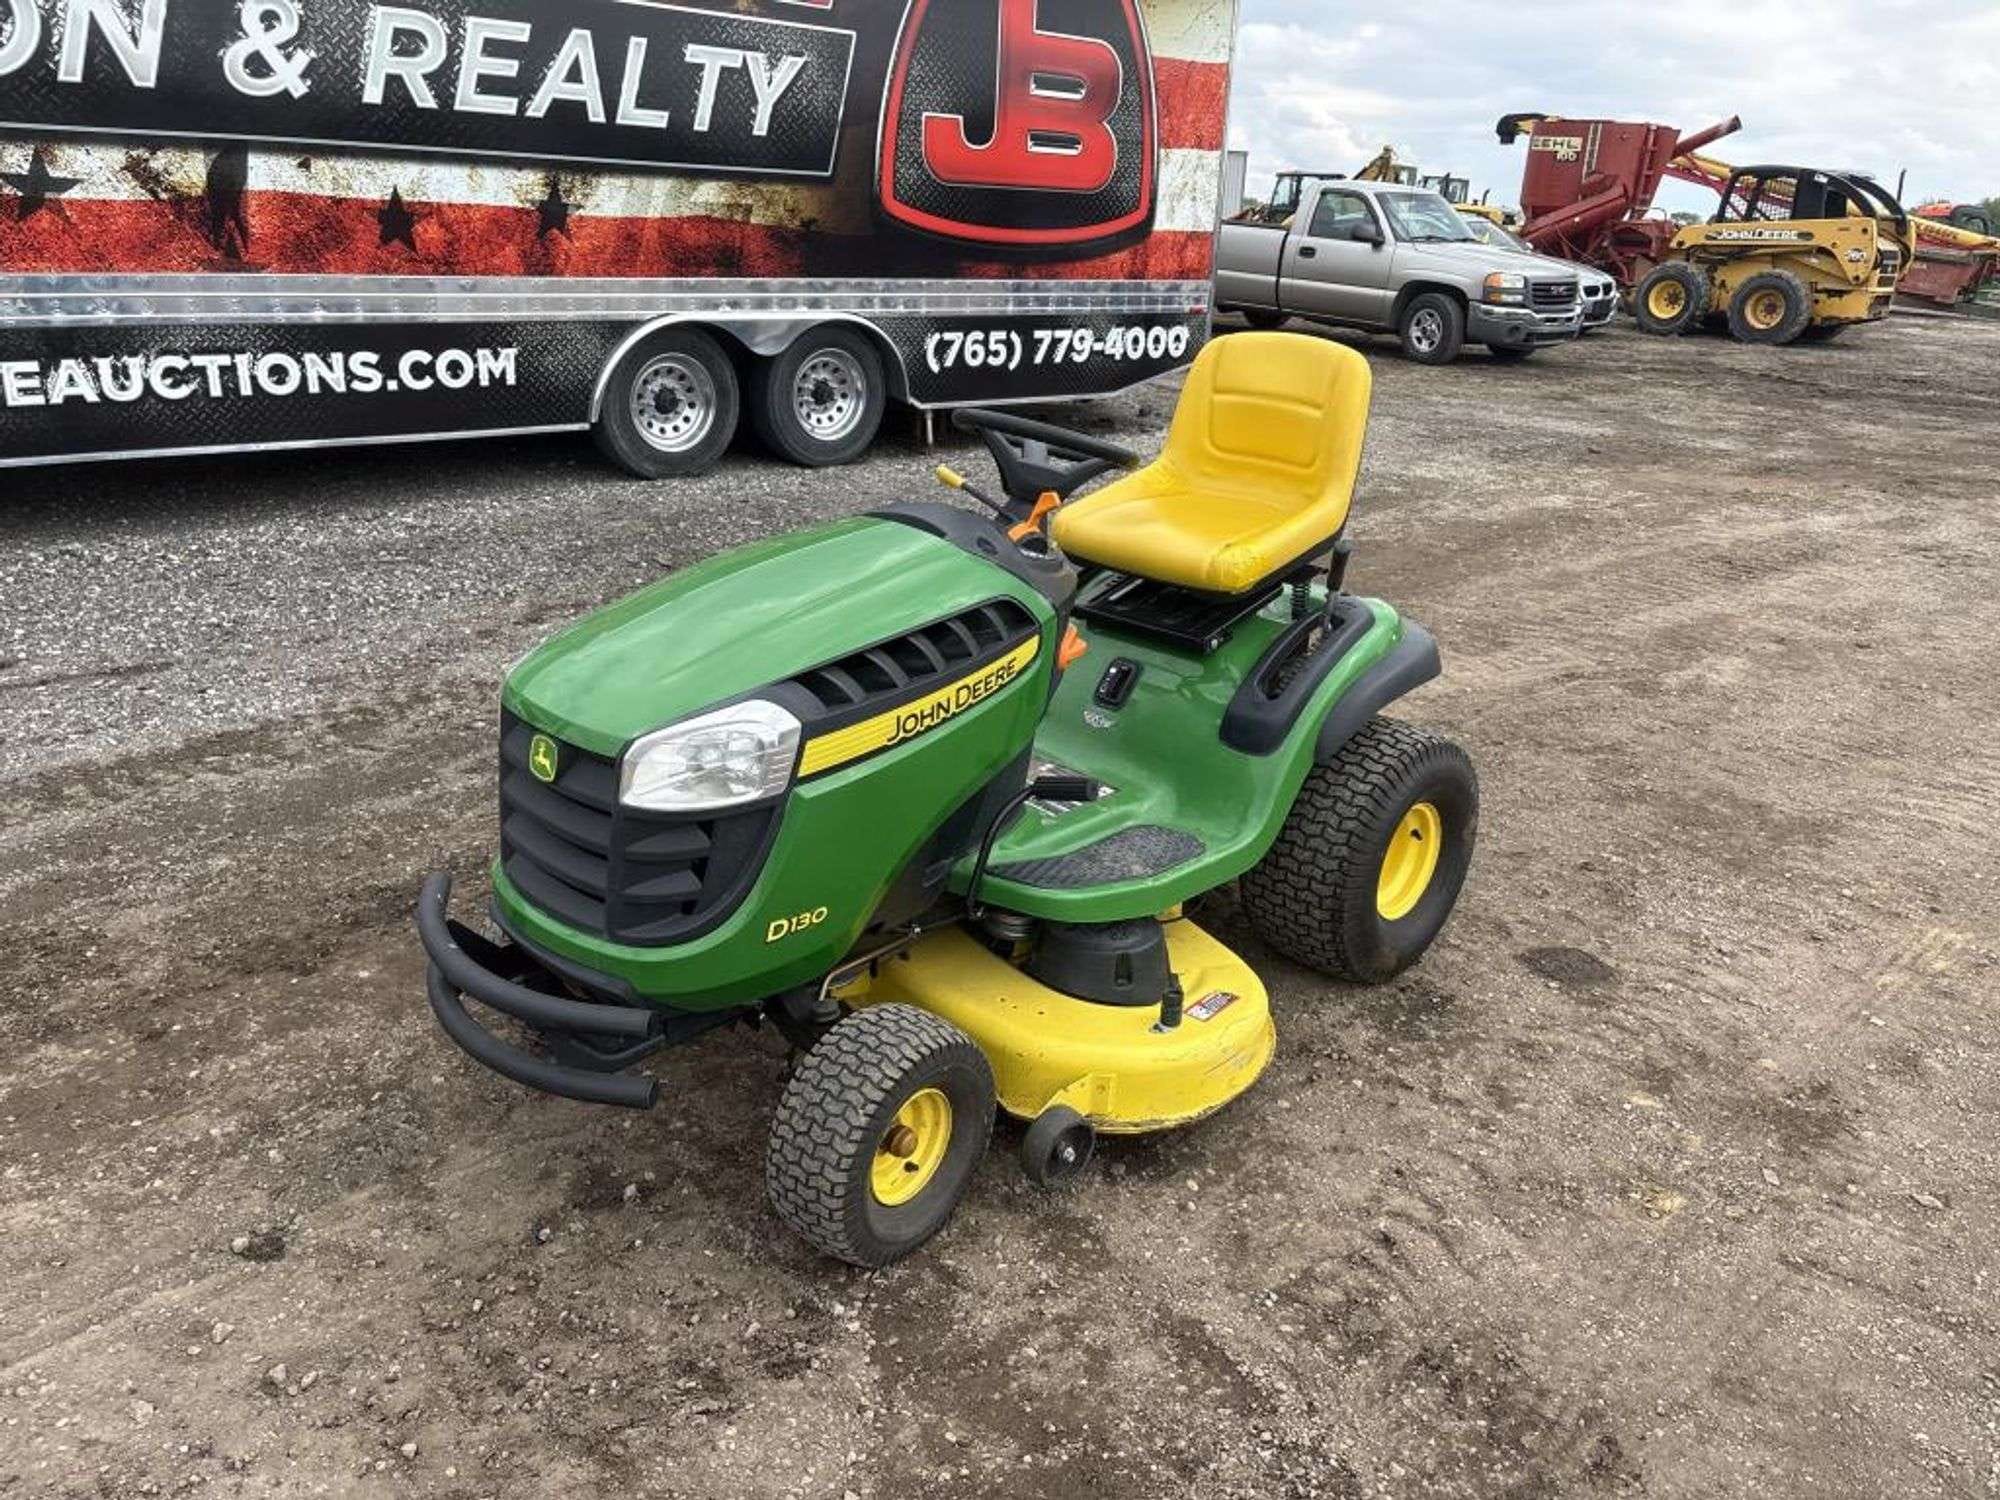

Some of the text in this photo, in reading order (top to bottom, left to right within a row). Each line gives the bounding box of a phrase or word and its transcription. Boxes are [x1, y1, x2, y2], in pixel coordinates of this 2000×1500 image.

[222, 0, 312, 98] &
[363, 6, 808, 136] REALTY
[921, 0, 1122, 192] JB
[0, 348, 518, 407] EAUCTIONS.COM
[926, 325, 1189, 374] (765) 779-4000
[887, 657, 1017, 742] JOHN DEERE
[765, 906, 828, 942] D130
